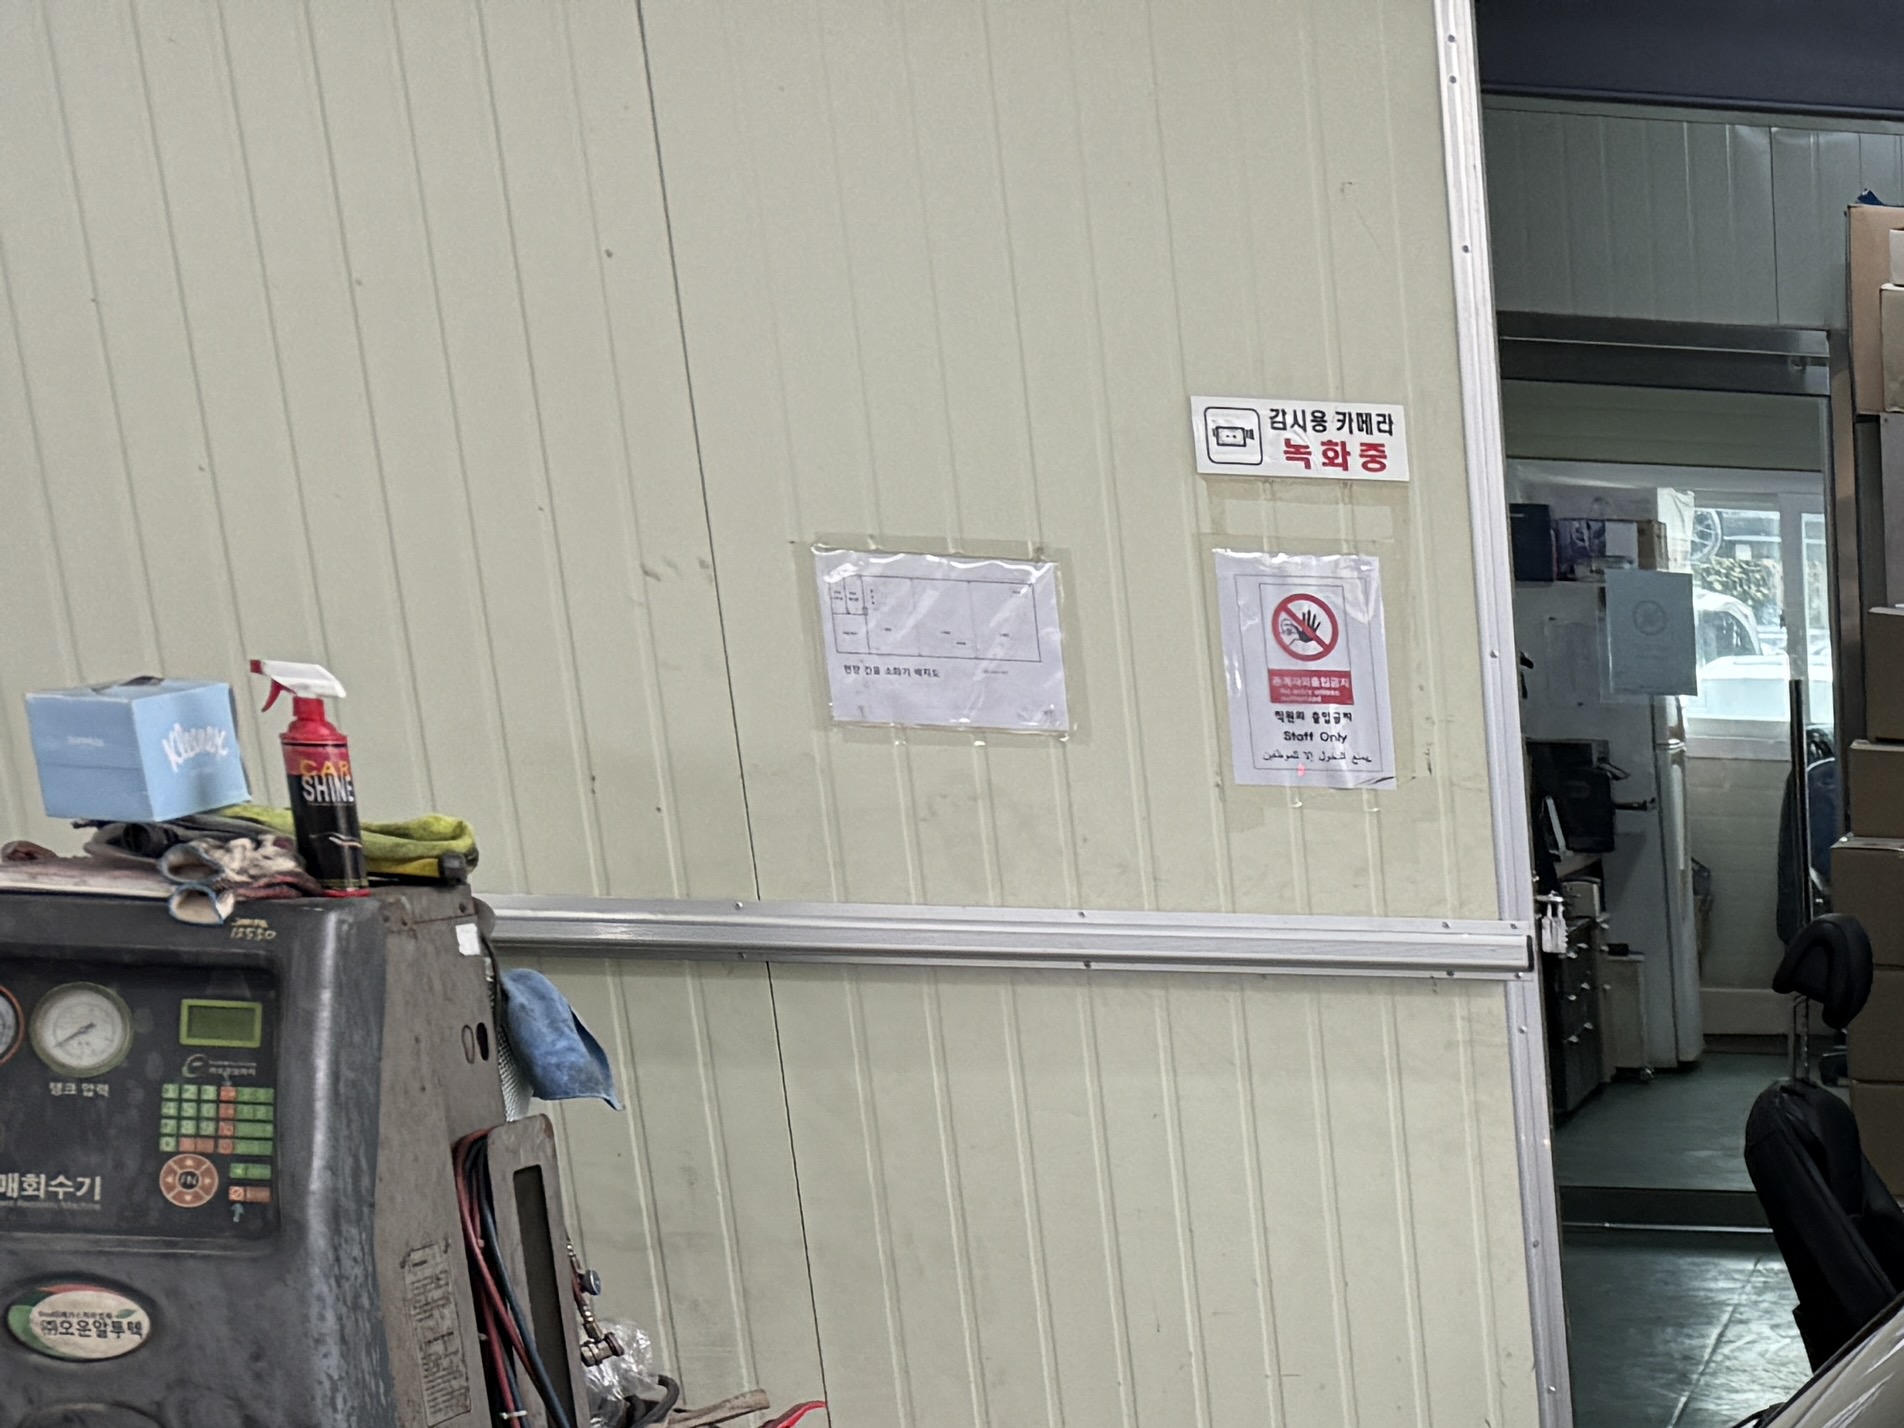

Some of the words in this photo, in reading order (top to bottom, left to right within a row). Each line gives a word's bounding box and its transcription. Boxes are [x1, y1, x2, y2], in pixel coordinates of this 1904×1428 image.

[1268, 408, 1328, 434] 감시용
[1334, 410, 1395, 436] 카메라
[161, 723, 229, 773] Kleenex
[1283, 731, 1314, 742] Staff
[1319, 731, 1348, 744] Only
[300, 759, 351, 777] CAR
[301, 775, 356, 803] SHINE
